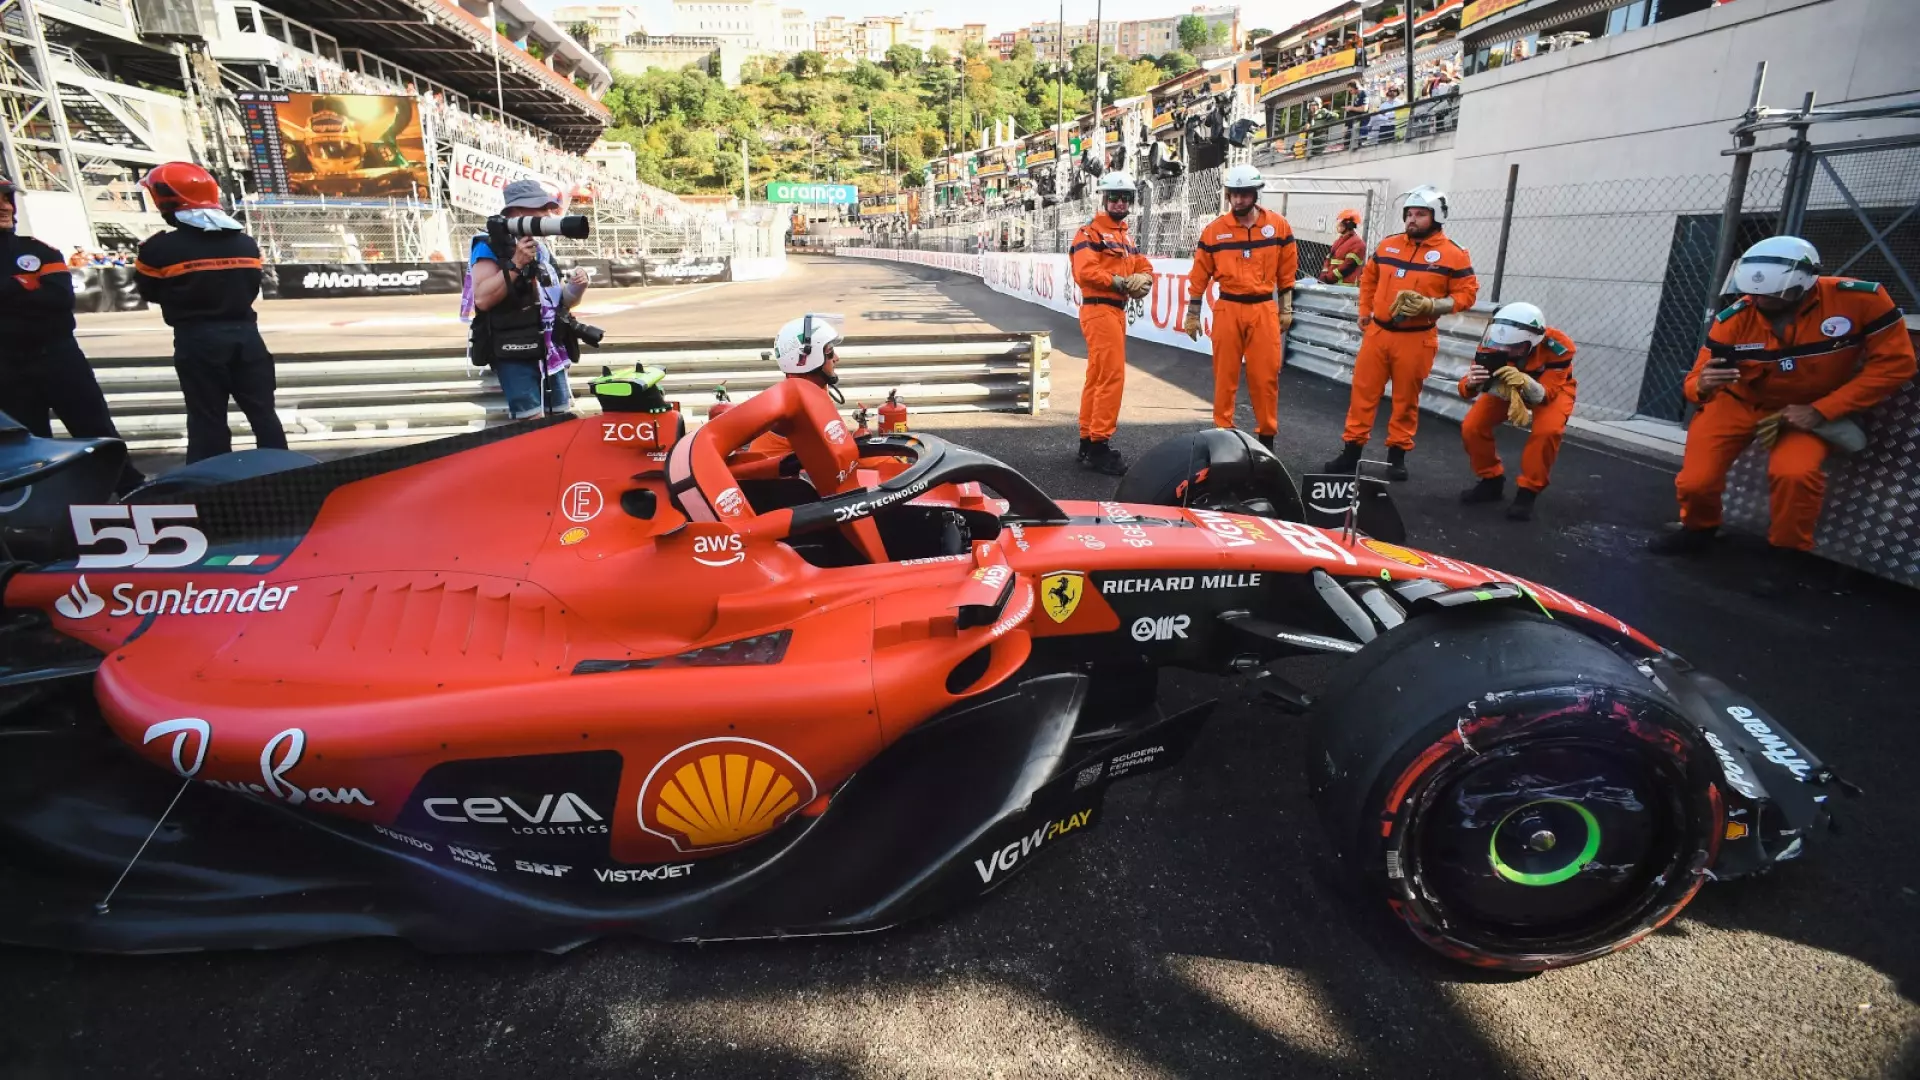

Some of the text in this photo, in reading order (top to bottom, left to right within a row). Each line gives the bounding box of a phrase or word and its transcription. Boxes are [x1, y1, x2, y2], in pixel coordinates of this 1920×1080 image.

[777, 185, 847, 200] aramco
[303, 270, 429, 289] #MonacoGP
[1035, 262, 1054, 299] UBS
[1780, 359, 1794, 371] 16
[1311, 481, 1360, 499] aws
[833, 480, 930, 522] DXC TECHNOLOGY
[69, 504, 208, 568] 55
[1188, 508, 1256, 547] VGW
[693, 533, 743, 553] aws
[1258, 517, 1358, 566] 55
[1103, 573, 1262, 594] RICHARD MILLE
[110, 580, 298, 617] Santander
[1109, 755, 1154, 772] FERRARI
[1112, 745, 1165, 764] SCUDERIA
[373, 824, 434, 852] brembo
[512, 824, 609, 836] LOGISTICS
[449, 844, 496, 866] NGK
[514, 859, 573, 878] SKF
